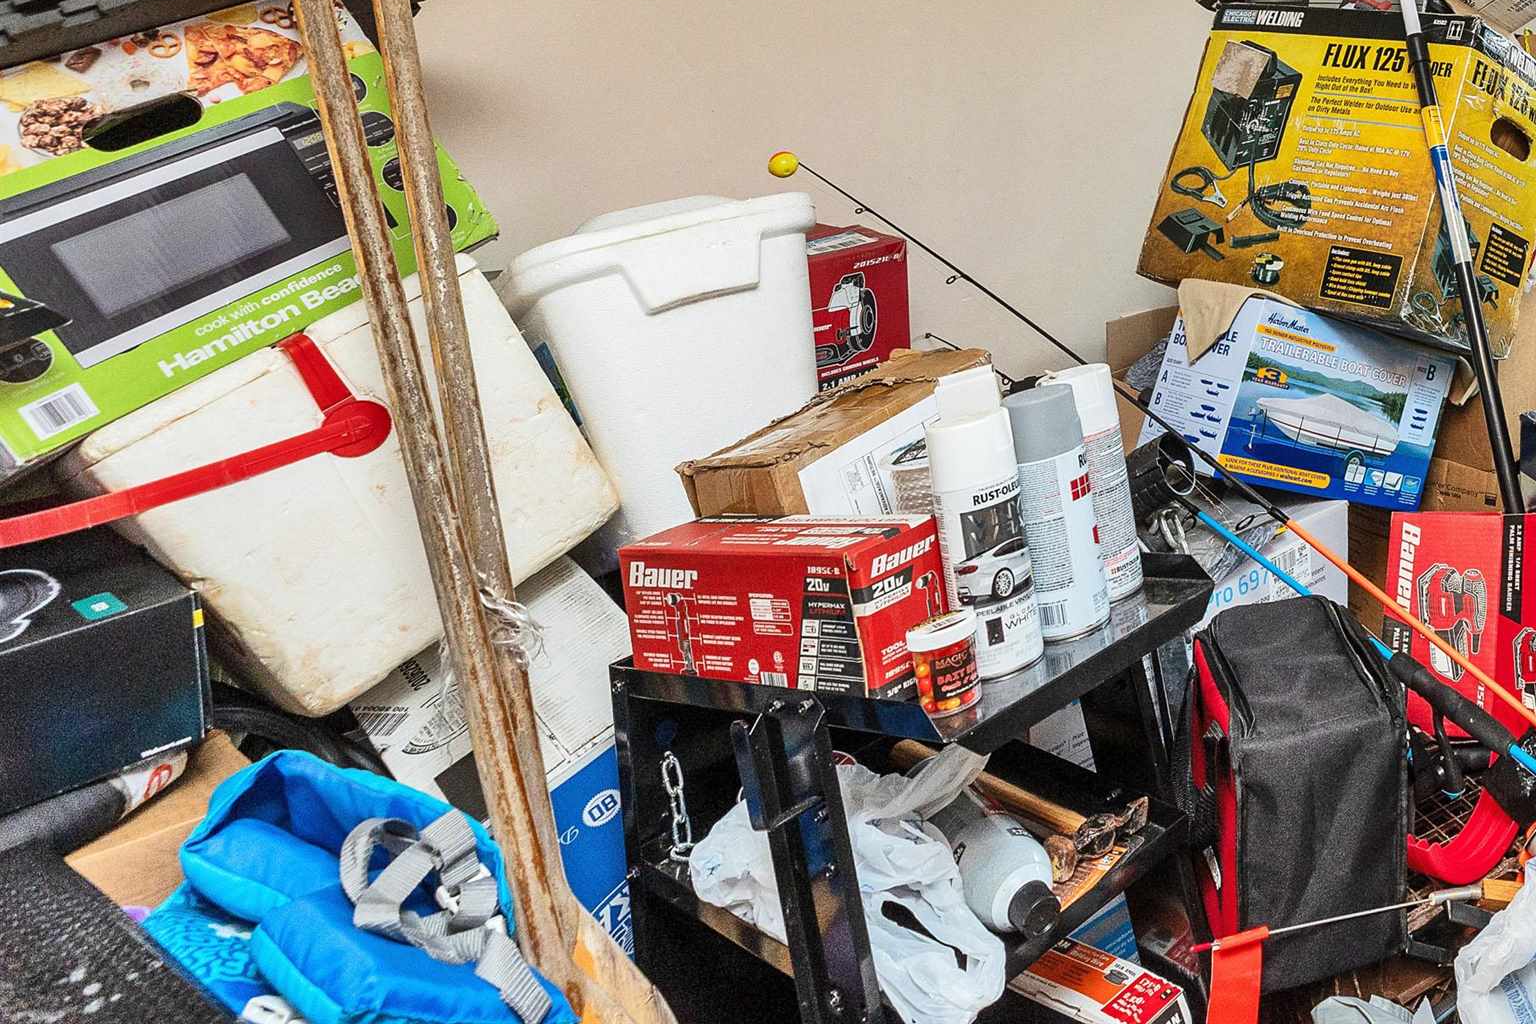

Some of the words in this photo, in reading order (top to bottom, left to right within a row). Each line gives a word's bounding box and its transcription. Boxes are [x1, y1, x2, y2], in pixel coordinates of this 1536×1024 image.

[1222, 15, 1255, 24] ELECTRIC
[1256, 10, 1304, 28] WELDING
[1322, 43, 1374, 69] FLUX
[1375, 46, 1407, 72] 125
[1314, 82, 1330, 91] Right
[1330, 84, 1341, 92] Out
[1360, 86, 1374, 94] Box!
[1317, 75, 1342, 84] Includes
[1342, 76, 1372, 88] Everything
[1386, 80, 1402, 88] Need
[1310, 96, 1320, 104] The
[1321, 97, 1343, 106] Perfect
[1343, 100, 1364, 108] Welder
[1374, 103, 1398, 112] Outdoor
[1316, 106, 1330, 114] Dirty
[1330, 107, 1351, 116] Metals
[195, 314, 230, 337] cook
[229, 300, 261, 320] with
[262, 262, 343, 306] confidence
[158, 304, 300, 378] Hamilton
[300, 272, 362, 311] Bea
[1261, 337, 1338, 368] TRAILERABLE
[1341, 359, 1371, 376] BOAT
[1372, 367, 1408, 388] COVER
[1160, 370, 1168, 383] A
[1266, 368, 1281, 380] 3
[1426, 364, 1436, 380] B
[822, 380, 835, 390] 2.1
[1154, 392, 1162, 405] B
[972, 480, 1020, 506] RUST-OLEU
[870, 534, 936, 578] Bauer
[629, 561, 698, 590] Bauer
[1396, 521, 1422, 616] Bauer
[881, 640, 907, 656] TOOL
[935, 653, 968, 669] MAGIC
